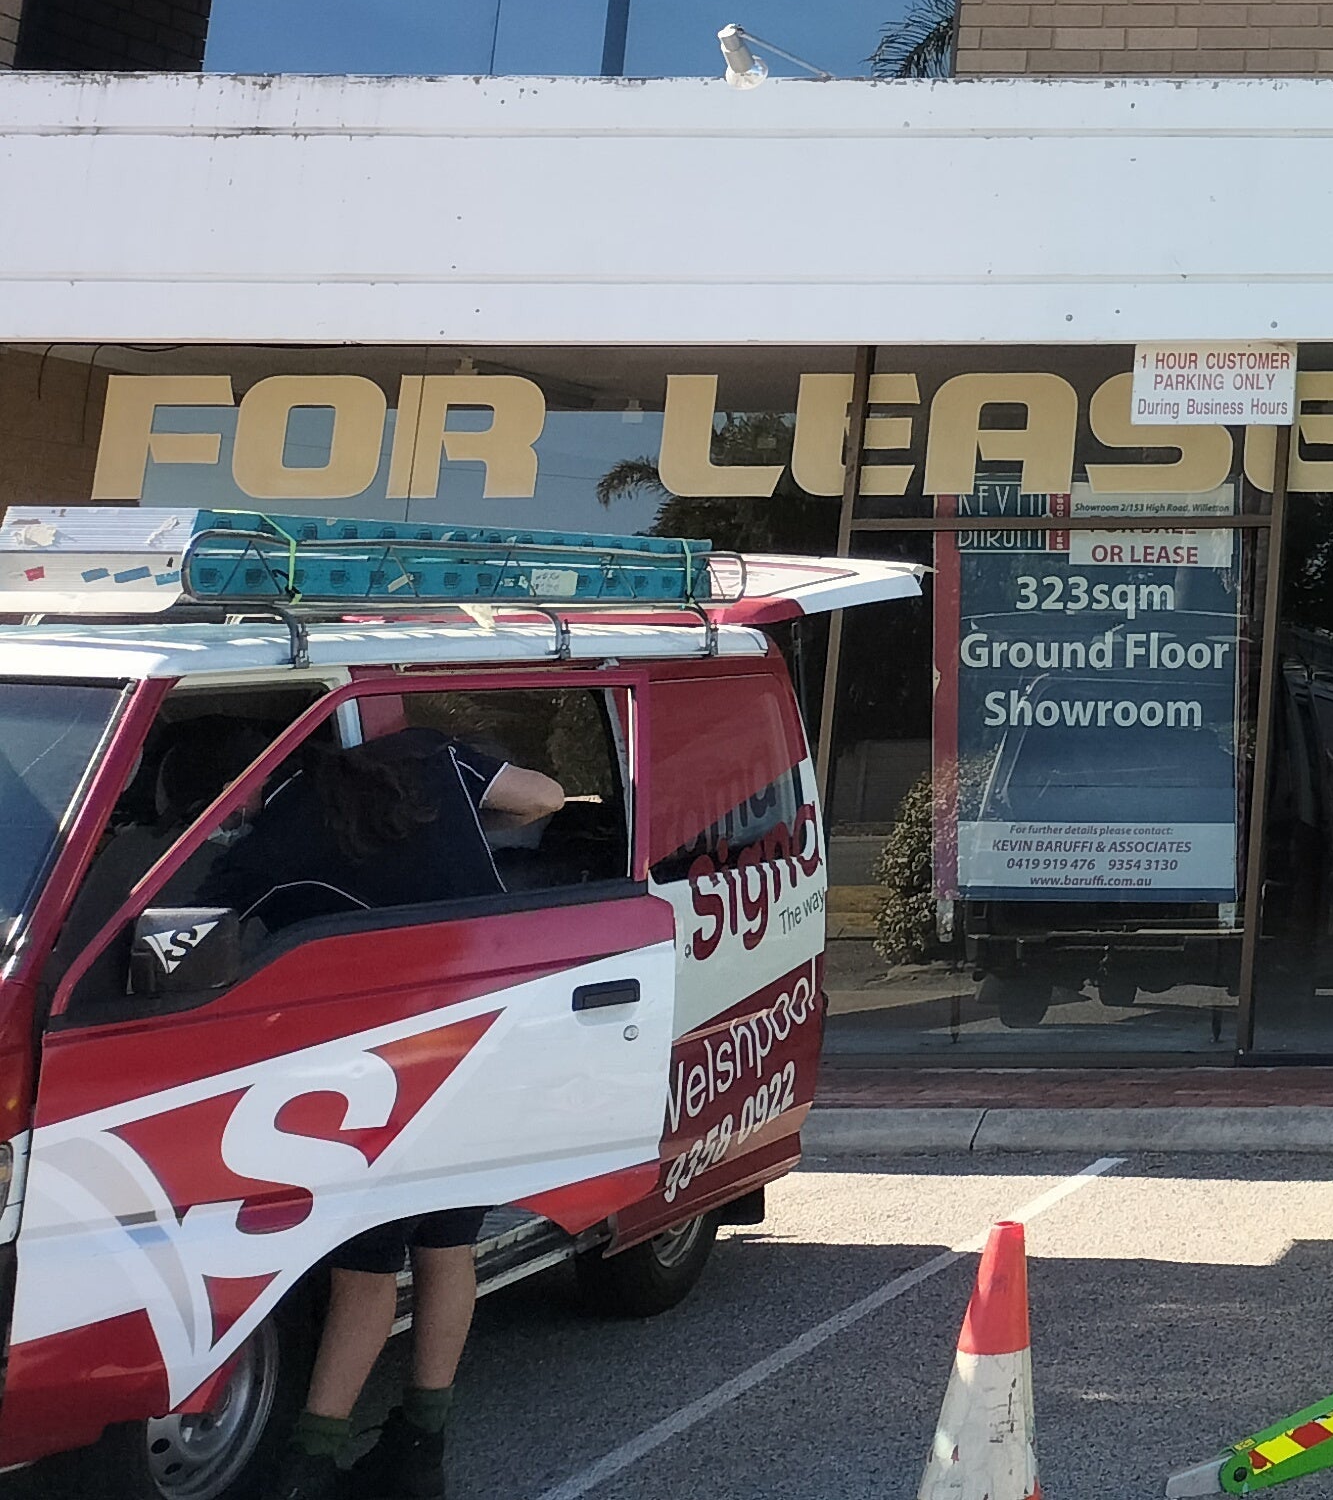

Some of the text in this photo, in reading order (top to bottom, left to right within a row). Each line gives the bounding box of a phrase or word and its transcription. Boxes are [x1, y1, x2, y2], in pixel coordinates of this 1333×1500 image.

[1141, 353, 1290, 370] 1 HOUR CUSTOMER
[1154, 373, 1276, 390] PARKING ONLY
[1138, 398, 1288, 419] During Business Hours
[91, 373, 546, 500] FOR
[1074, 502, 1119, 512] Showroom
[1120, 503, 1145, 512] 2/153
[1146, 503, 1166, 514] High
[1092, 544, 1199, 564] OR LEASE
[1015, 576, 1175, 619] 323sqm
[960, 631, 1230, 669] Ground Floor
[984, 690, 1202, 727] Showroom
[1010, 825, 1174, 838] For further details please contact:
[992, 840, 1192, 853] KEVIN BARUFFI & ASSOCIATES
[1006, 858, 1178, 871] 0419 919 476 9354 3130
[1030, 875, 1152, 887] www.baruffi.com.au
[779, 903, 802, 935] The
[664, 1060, 796, 1203] 9358 0922
